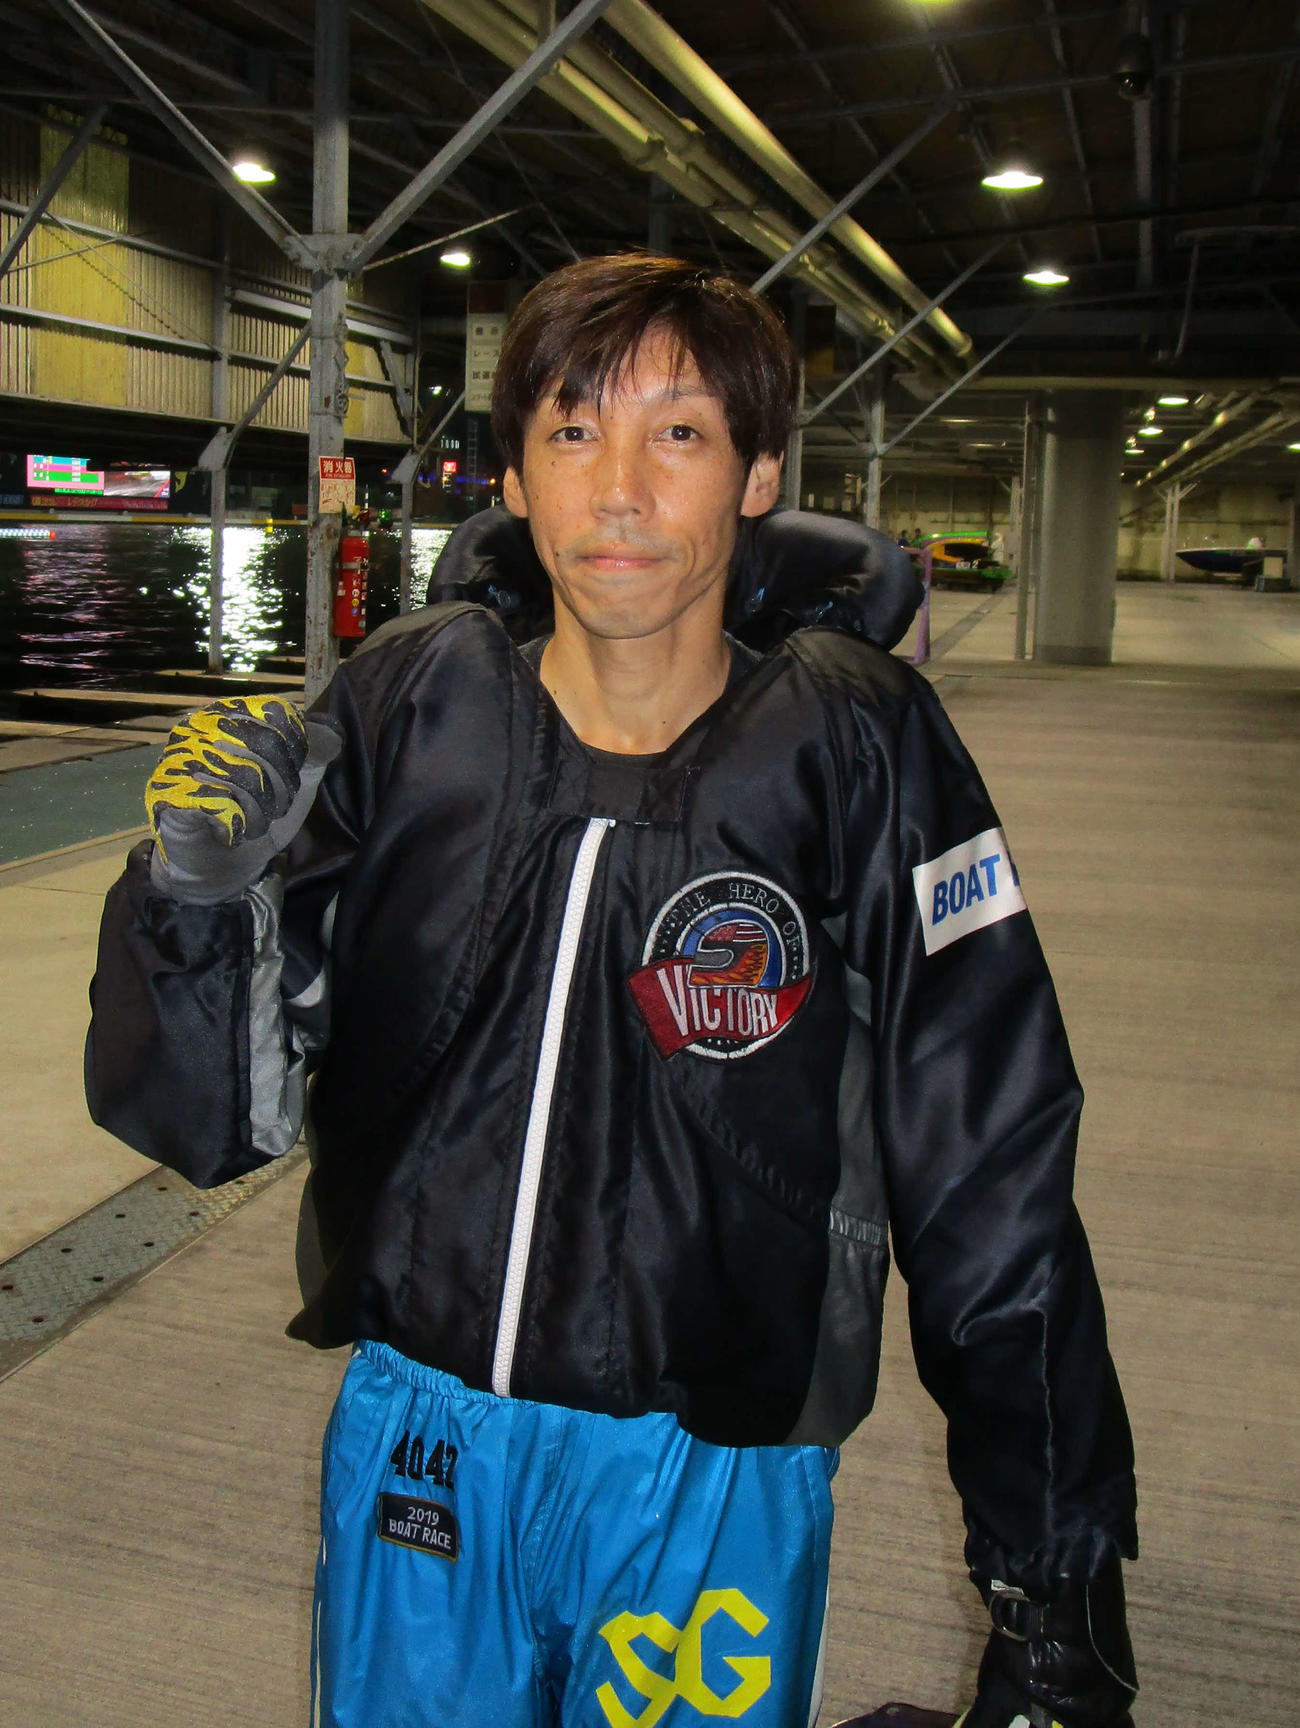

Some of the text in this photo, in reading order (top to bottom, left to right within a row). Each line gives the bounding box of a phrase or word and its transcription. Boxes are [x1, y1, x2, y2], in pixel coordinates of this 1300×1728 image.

[728, 882, 780, 914] HERO
[932, 853, 1001, 926] BOAT
[656, 964, 778, 1038] VICTORY
[390, 1429, 459, 1493] 4042
[388, 1518, 452, 1550] BOAT RACE
[407, 1506, 440, 1526] 2019
[595, 1587, 772, 1728] SG
